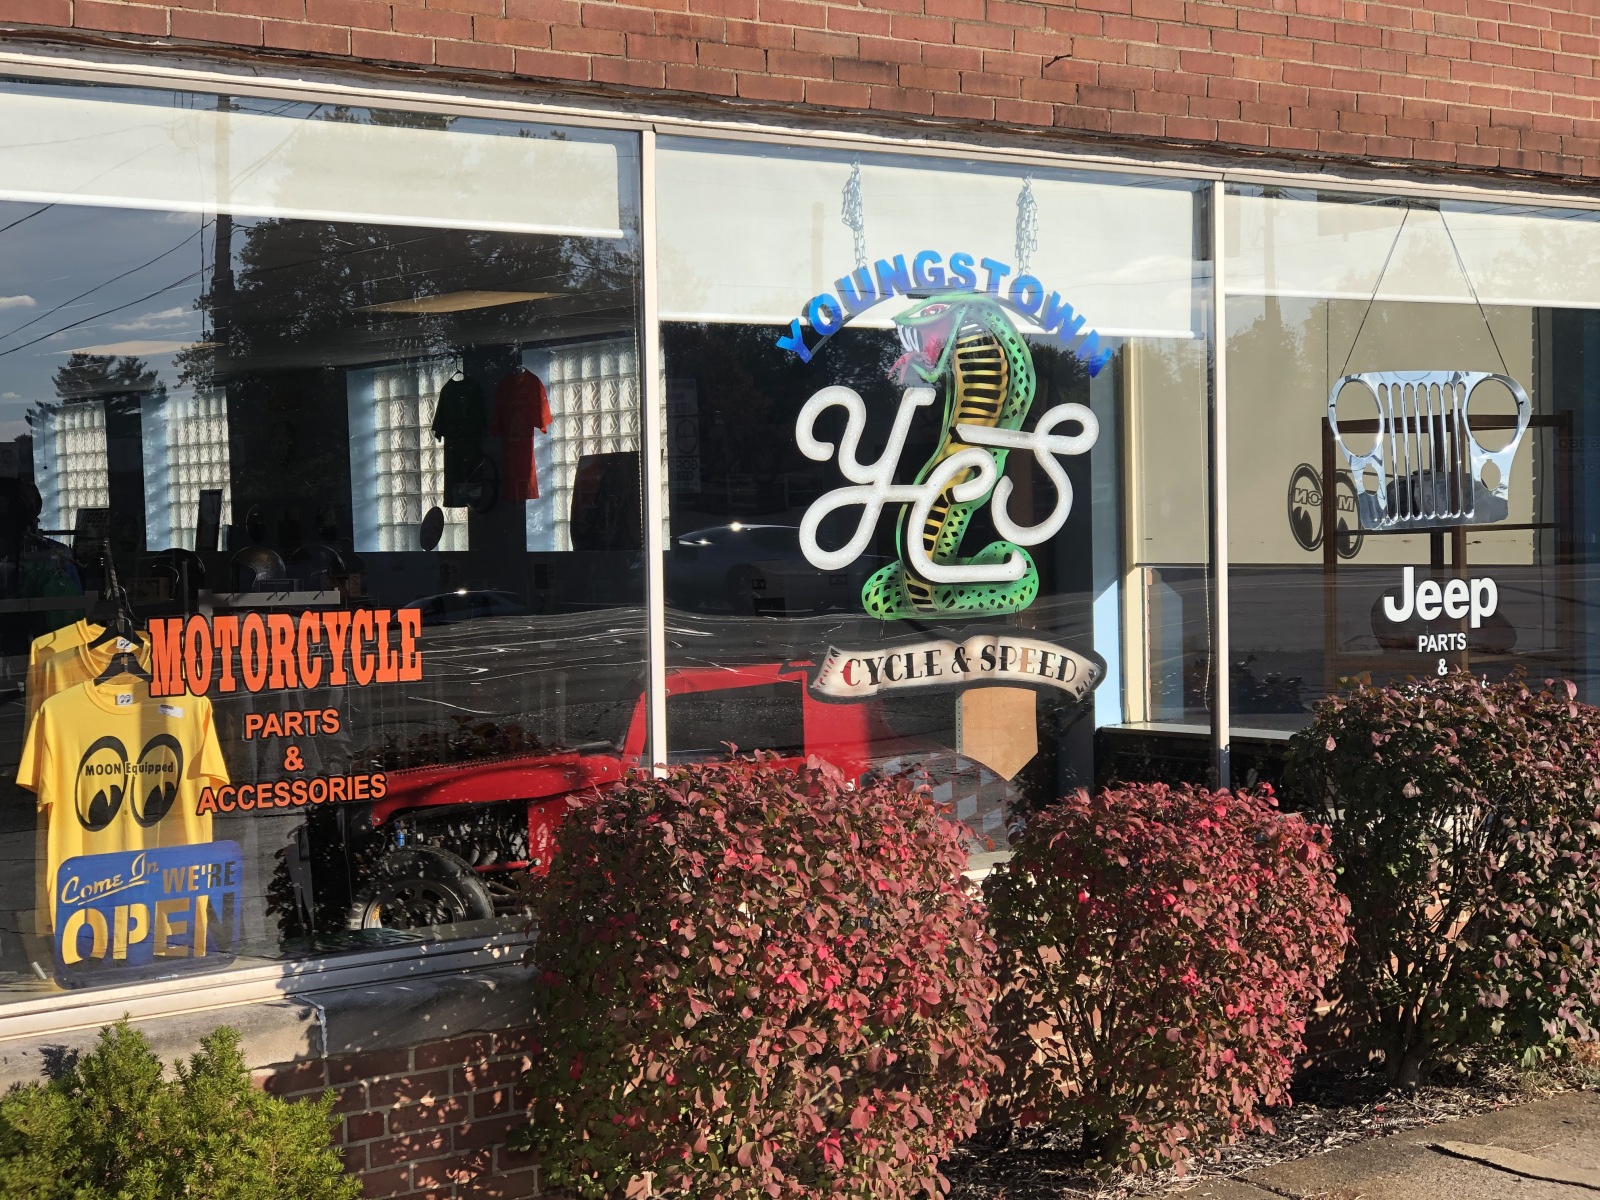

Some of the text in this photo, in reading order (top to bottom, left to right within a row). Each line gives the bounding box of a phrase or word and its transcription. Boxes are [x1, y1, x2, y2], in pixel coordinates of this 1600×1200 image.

[775, 250, 1113, 378] YOUNGSTOWN
[1384, 566, 1498, 628] Jeep
[148, 608, 423, 697] MOTORCYCLE
[1418, 632, 1467, 653] PARTS
[840, 644, 1077, 687] CYCLE & SPEED
[1437, 658, 1448, 676] &
[244, 708, 340, 740] PARTS
[85, 762, 174, 776] MOON Equipped
[284, 746, 305, 771] &
[196, 773, 387, 815] ACCESSORIES
[61, 852, 159, 904] Come In
[163, 861, 236, 894] WE'RE
[61, 892, 235, 965] OPEN
